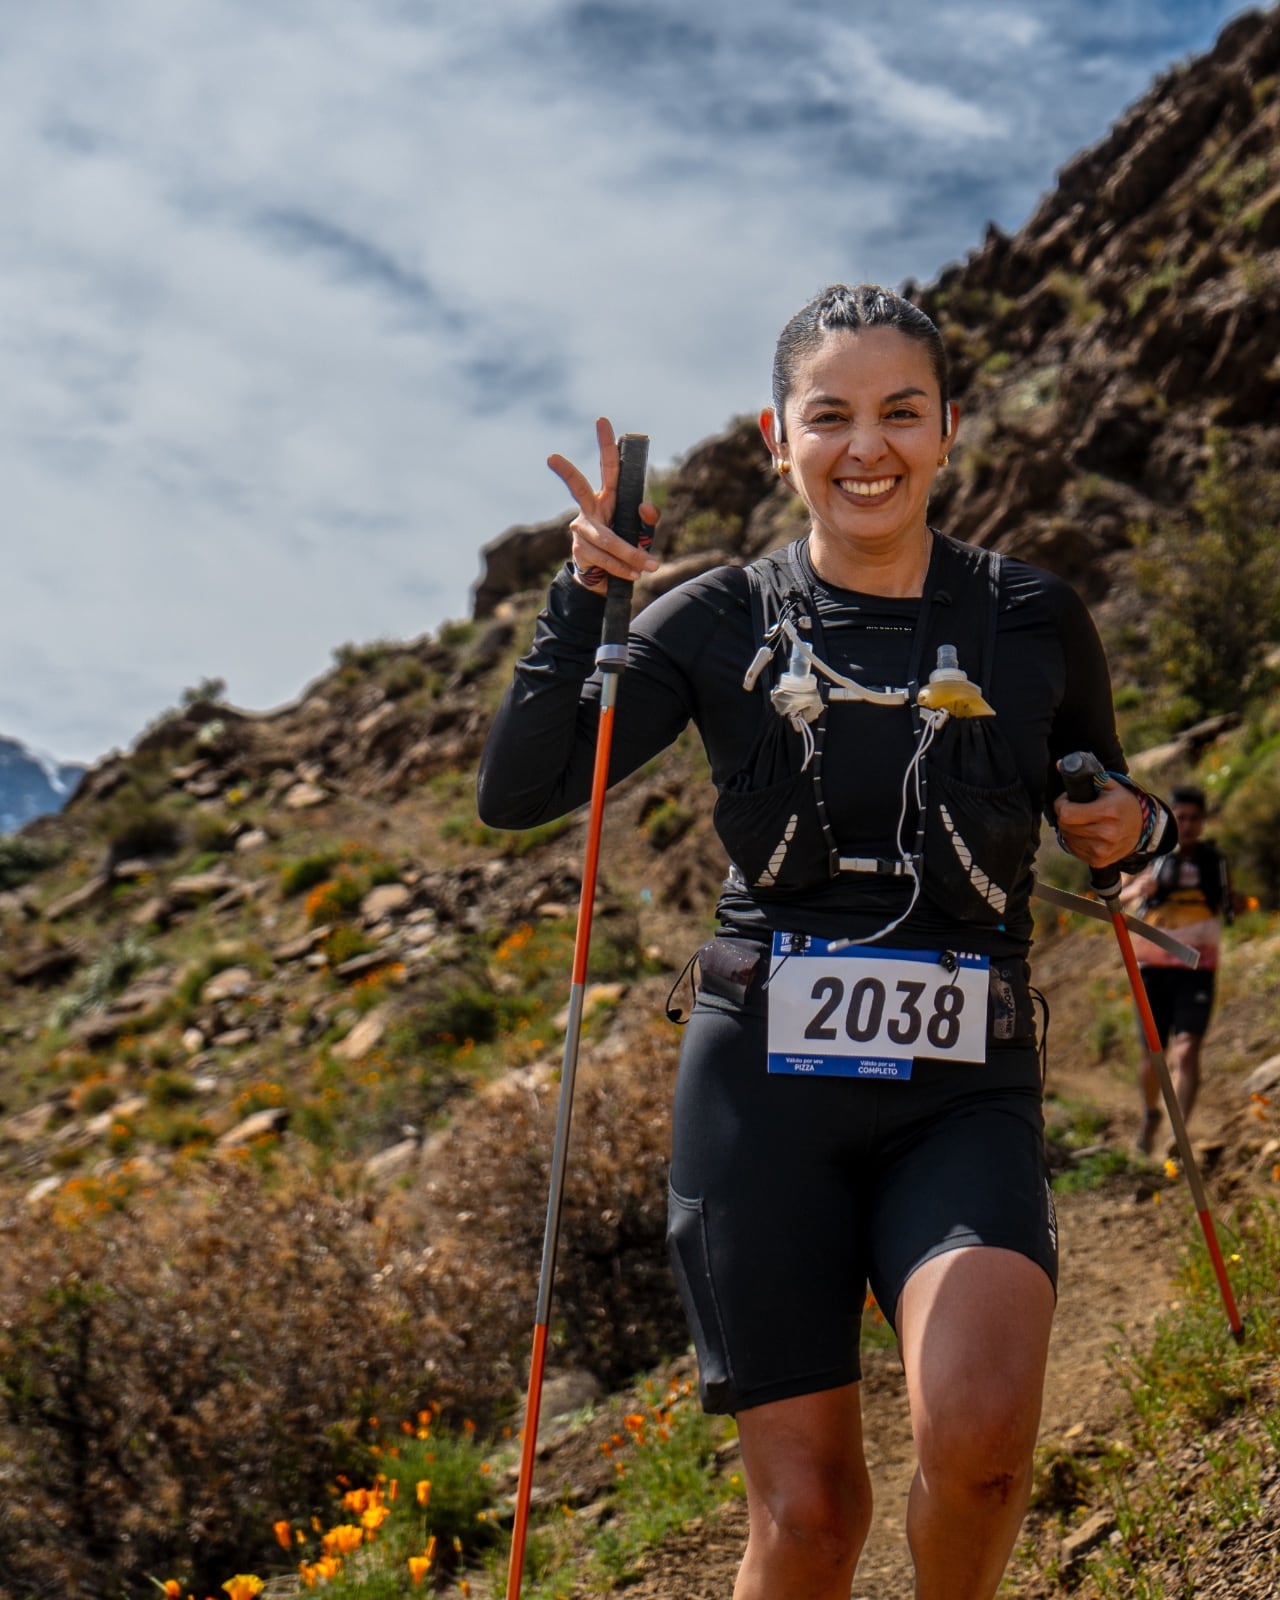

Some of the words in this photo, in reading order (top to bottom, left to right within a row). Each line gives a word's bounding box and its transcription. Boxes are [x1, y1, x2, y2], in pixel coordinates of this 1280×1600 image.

[804, 976, 965, 1049] 2038
[794, 1063, 815, 1072] PIZZA
[858, 1066, 898, 1076] COMPLETO
